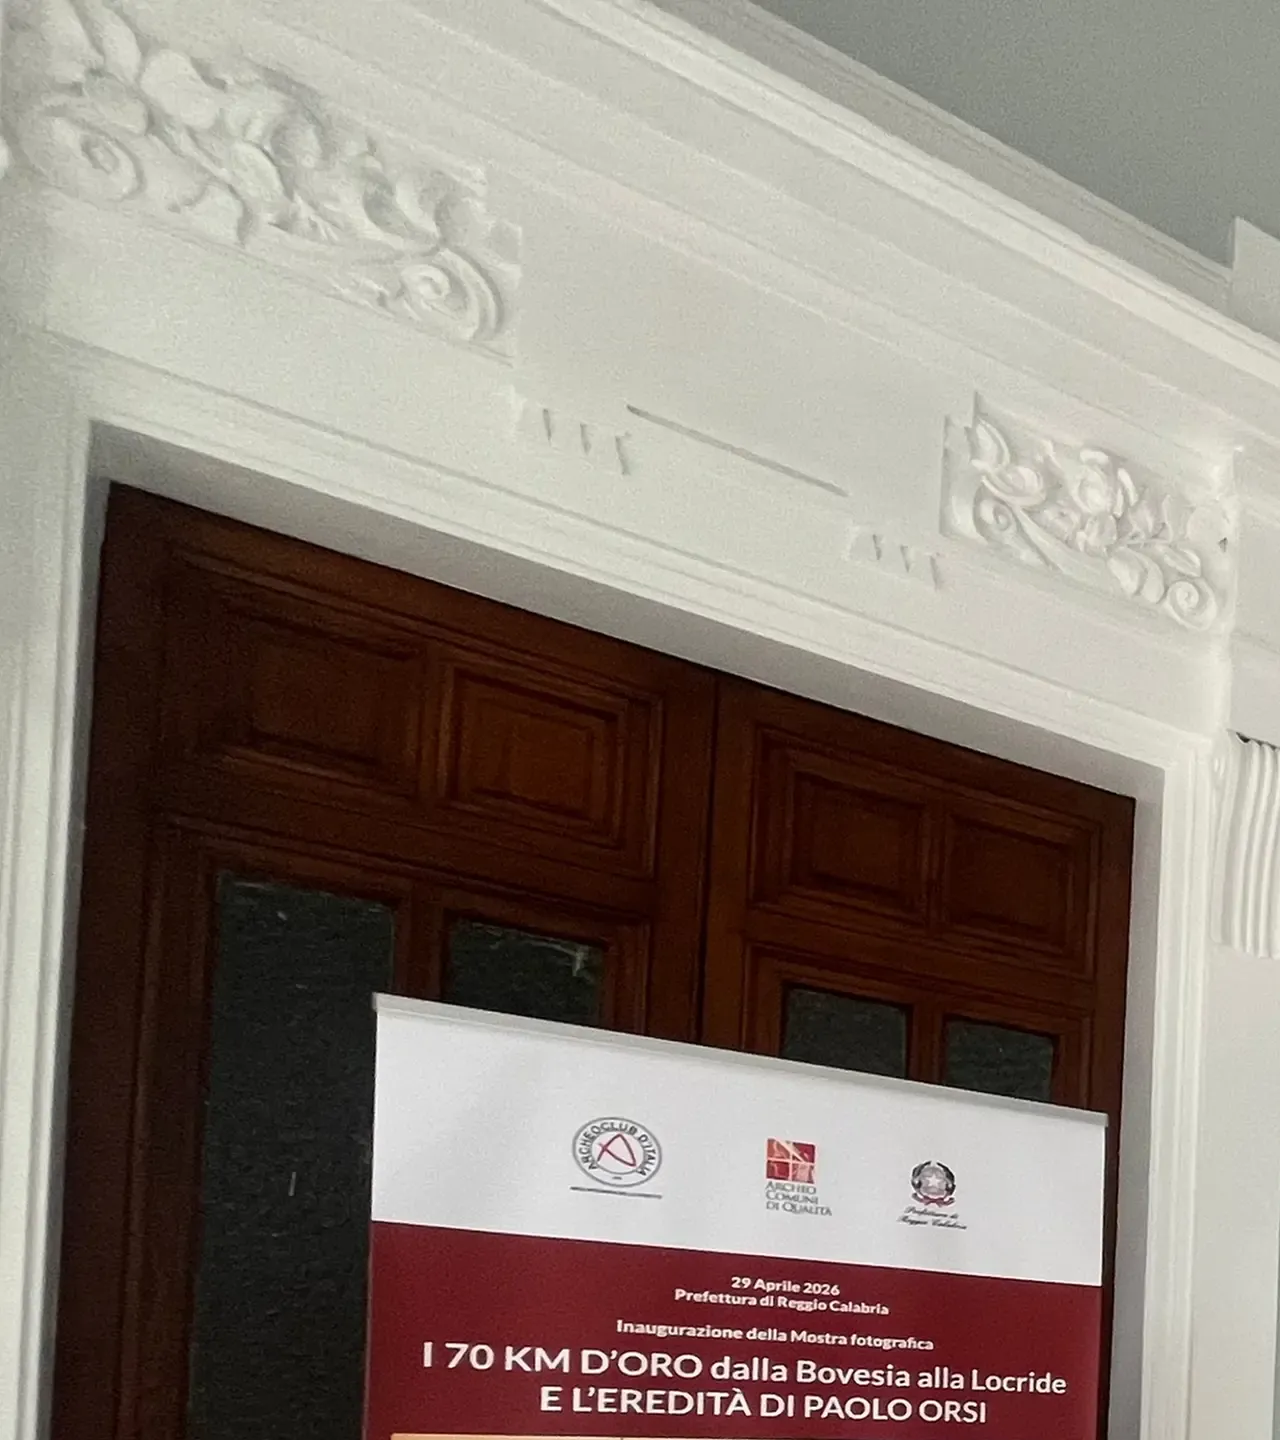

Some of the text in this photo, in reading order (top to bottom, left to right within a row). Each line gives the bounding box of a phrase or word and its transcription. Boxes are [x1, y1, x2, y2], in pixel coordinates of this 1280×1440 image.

[578, 1122, 638, 1170] ARCHEOCLUB
[673, 1287, 890, 1315] Prefettura di Reggio Calabria
[730, 1275, 841, 1296] 29 Aprile 2026
[616, 1318, 934, 1350] Inaugurazione della Mostra fotografica
[423, 1341, 1067, 1394] I 70 KM D'ORO dalla Bovesia alla Locride
[540, 1385, 986, 1423] E L'EREDITÀ DI PAOLO ORSI
